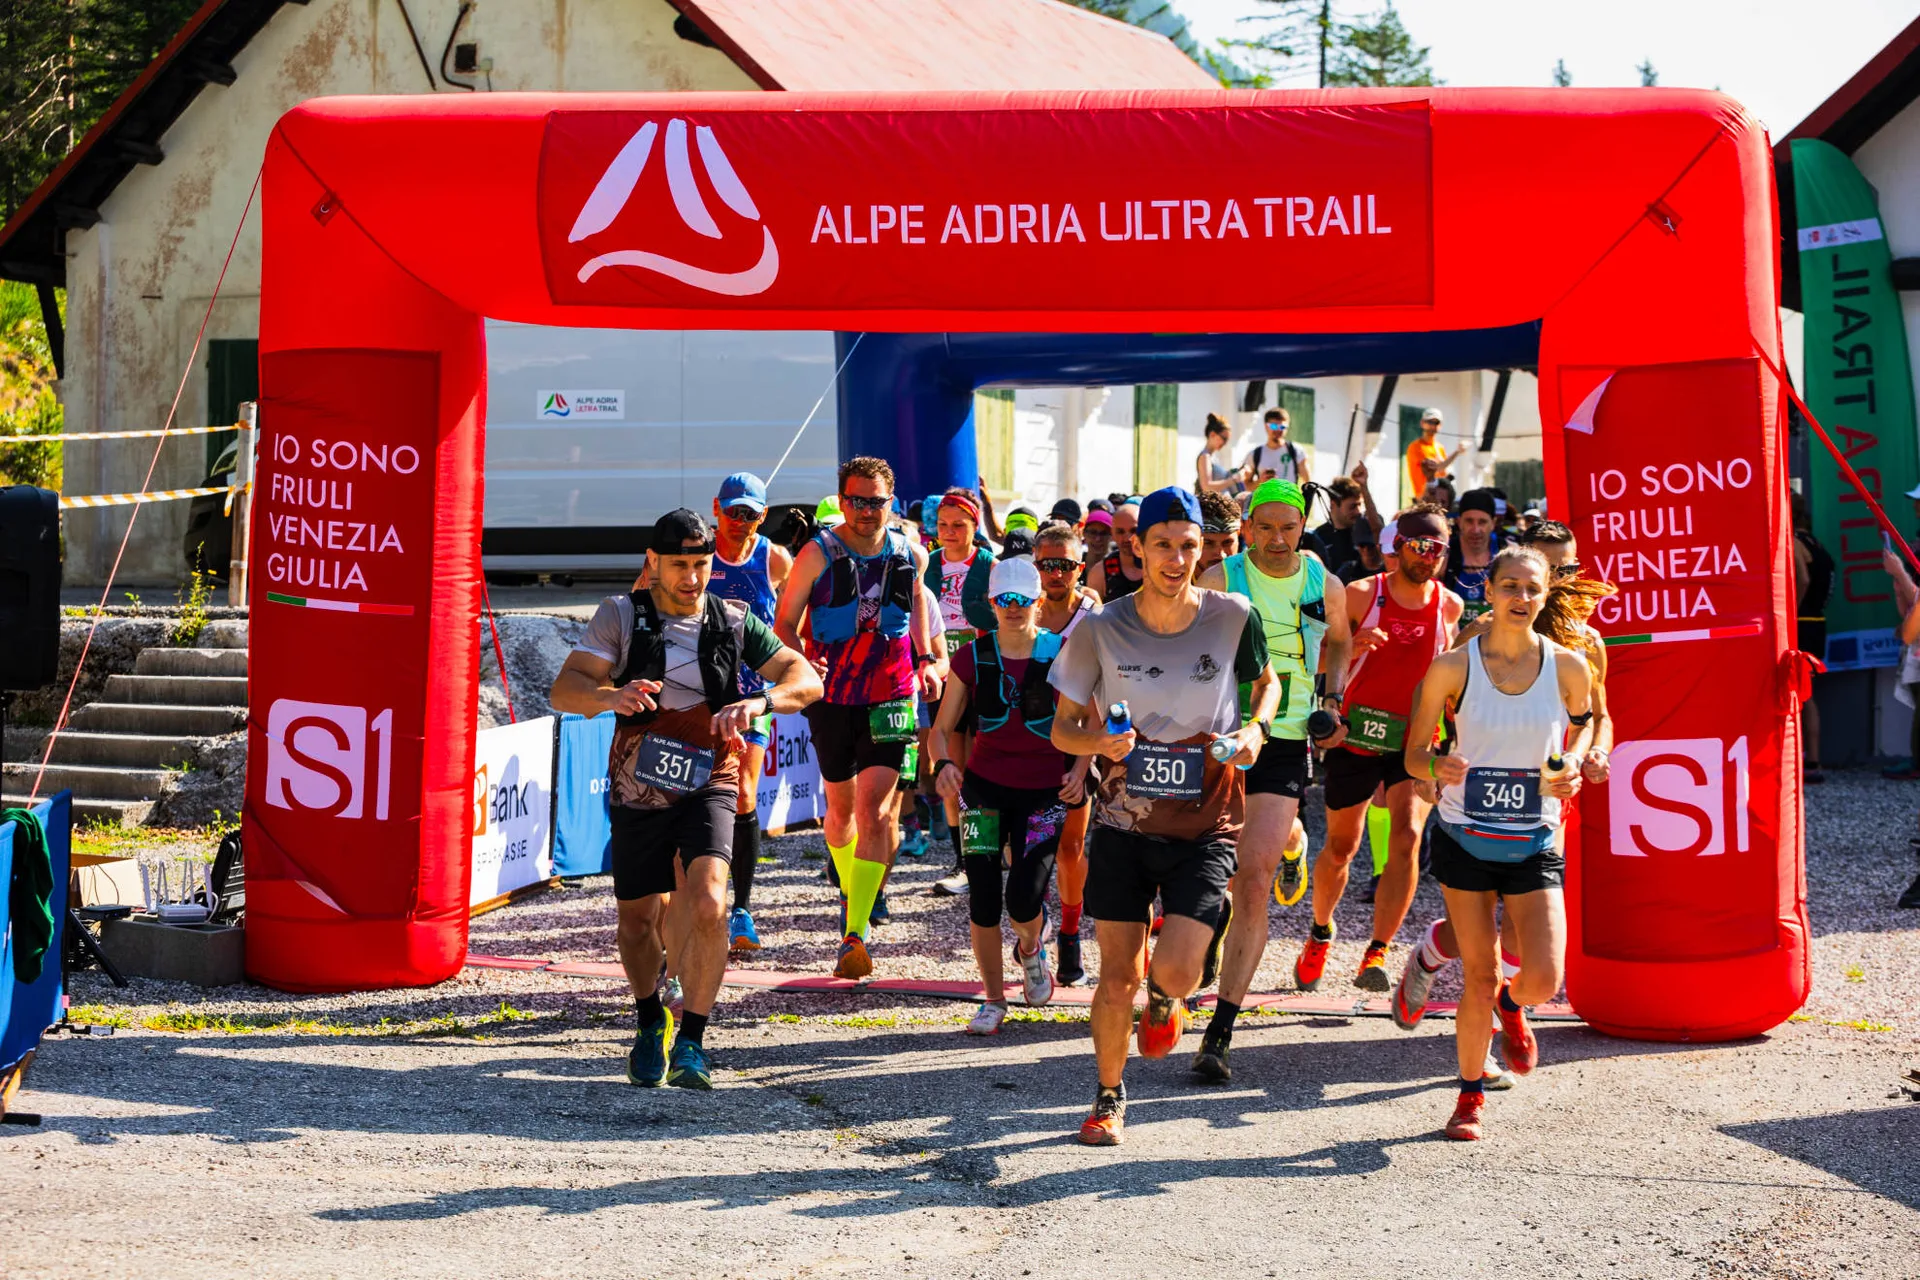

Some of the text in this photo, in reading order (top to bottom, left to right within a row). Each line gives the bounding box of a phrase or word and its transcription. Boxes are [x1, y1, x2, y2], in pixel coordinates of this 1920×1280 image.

[810, 194, 1392, 244] ALPE ADRIA ULTRA TRAIL
[273, 433, 420, 474] IO SONO
[271, 473, 352, 510] FRIULI
[1590, 457, 1752, 502] IO SONO
[269, 512, 404, 554] VENEZIA
[1592, 505, 1693, 543] FRIULI
[267, 552, 368, 591] GIULIA
[1594, 542, 1747, 583] VENEZIA
[1597, 586, 1717, 625] GIULIA
[887, 712, 909, 728] 107
[1363, 720, 1387, 739] 125
[655, 750, 693, 782] 351
[1142, 757, 1186, 785] 350
[490, 782, 529, 825] Bank
[1482, 783, 1525, 809] 349
